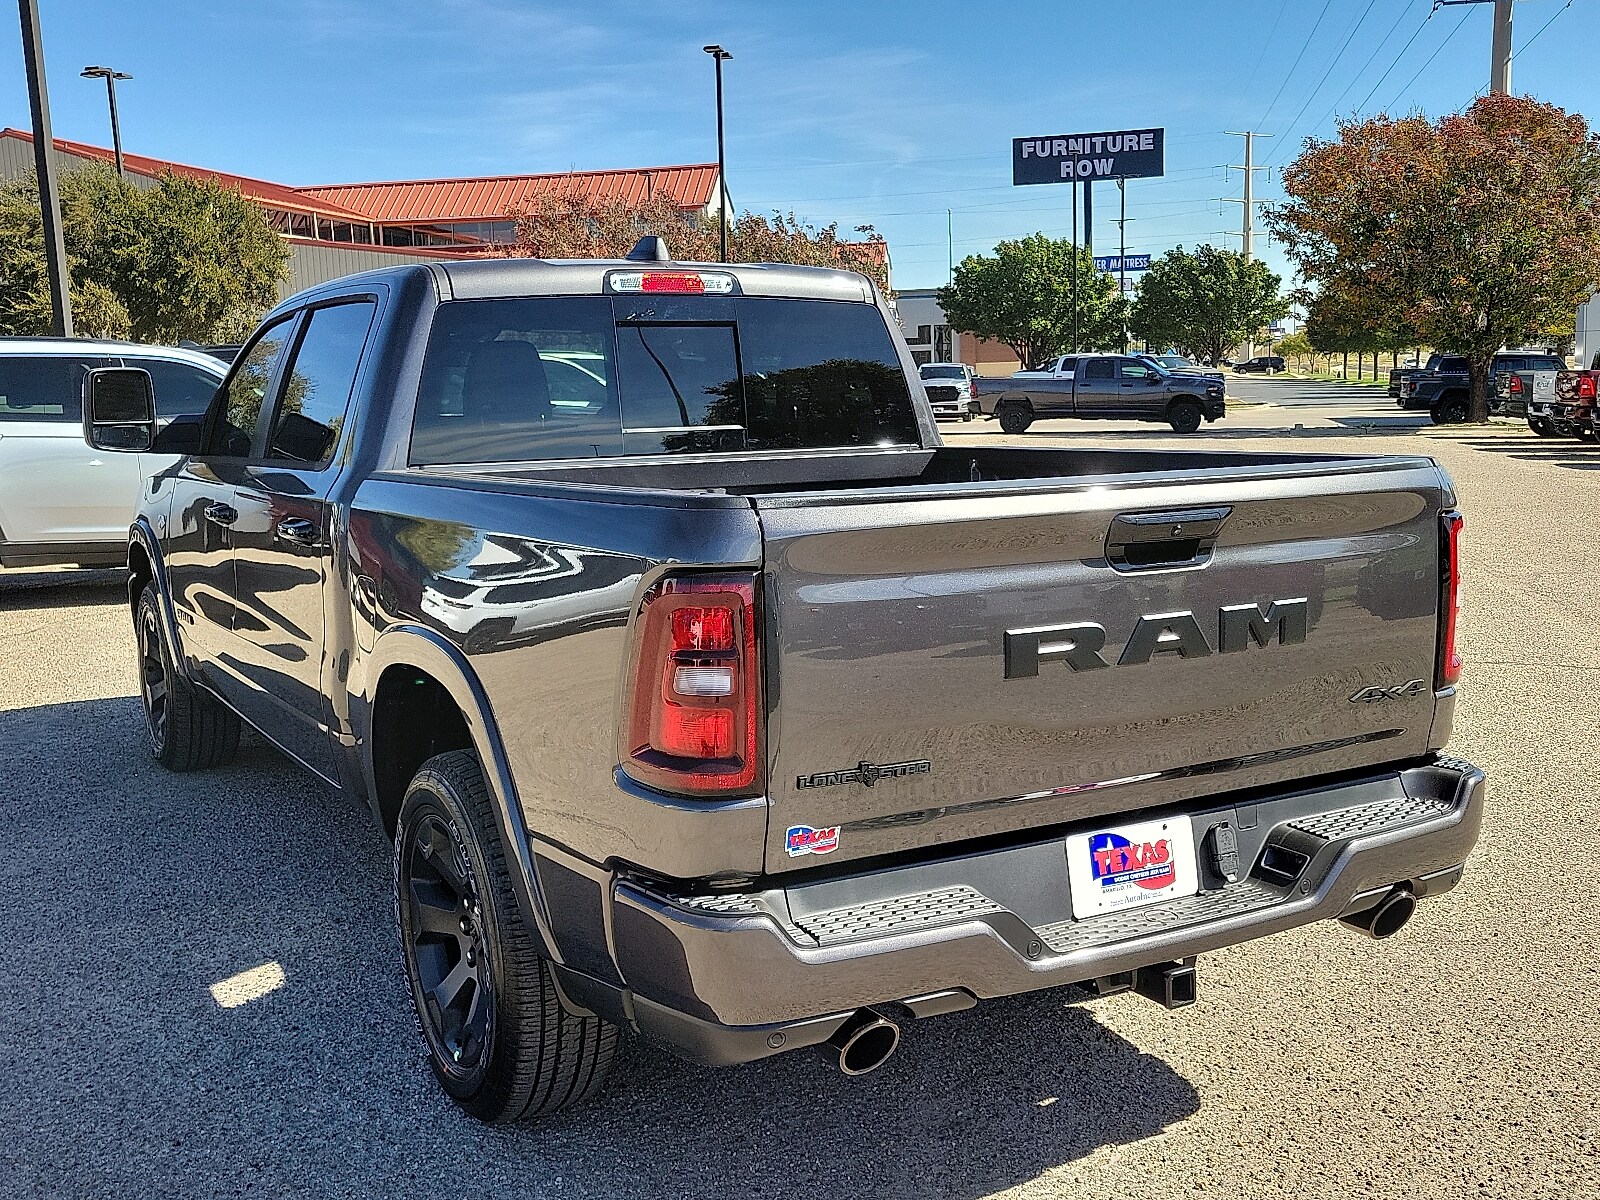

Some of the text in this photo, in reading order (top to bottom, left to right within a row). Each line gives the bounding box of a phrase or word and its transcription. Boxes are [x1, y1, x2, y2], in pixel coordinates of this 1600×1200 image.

[1021, 133, 1155, 158] FURNITURE
[1060, 158, 1114, 178] ROW
[1003, 597, 1308, 681] RAM
[797, 759, 931, 790] LONE STAR
[789, 828, 836, 846] TEXAS
[1093, 839, 1170, 875] TEXAS
